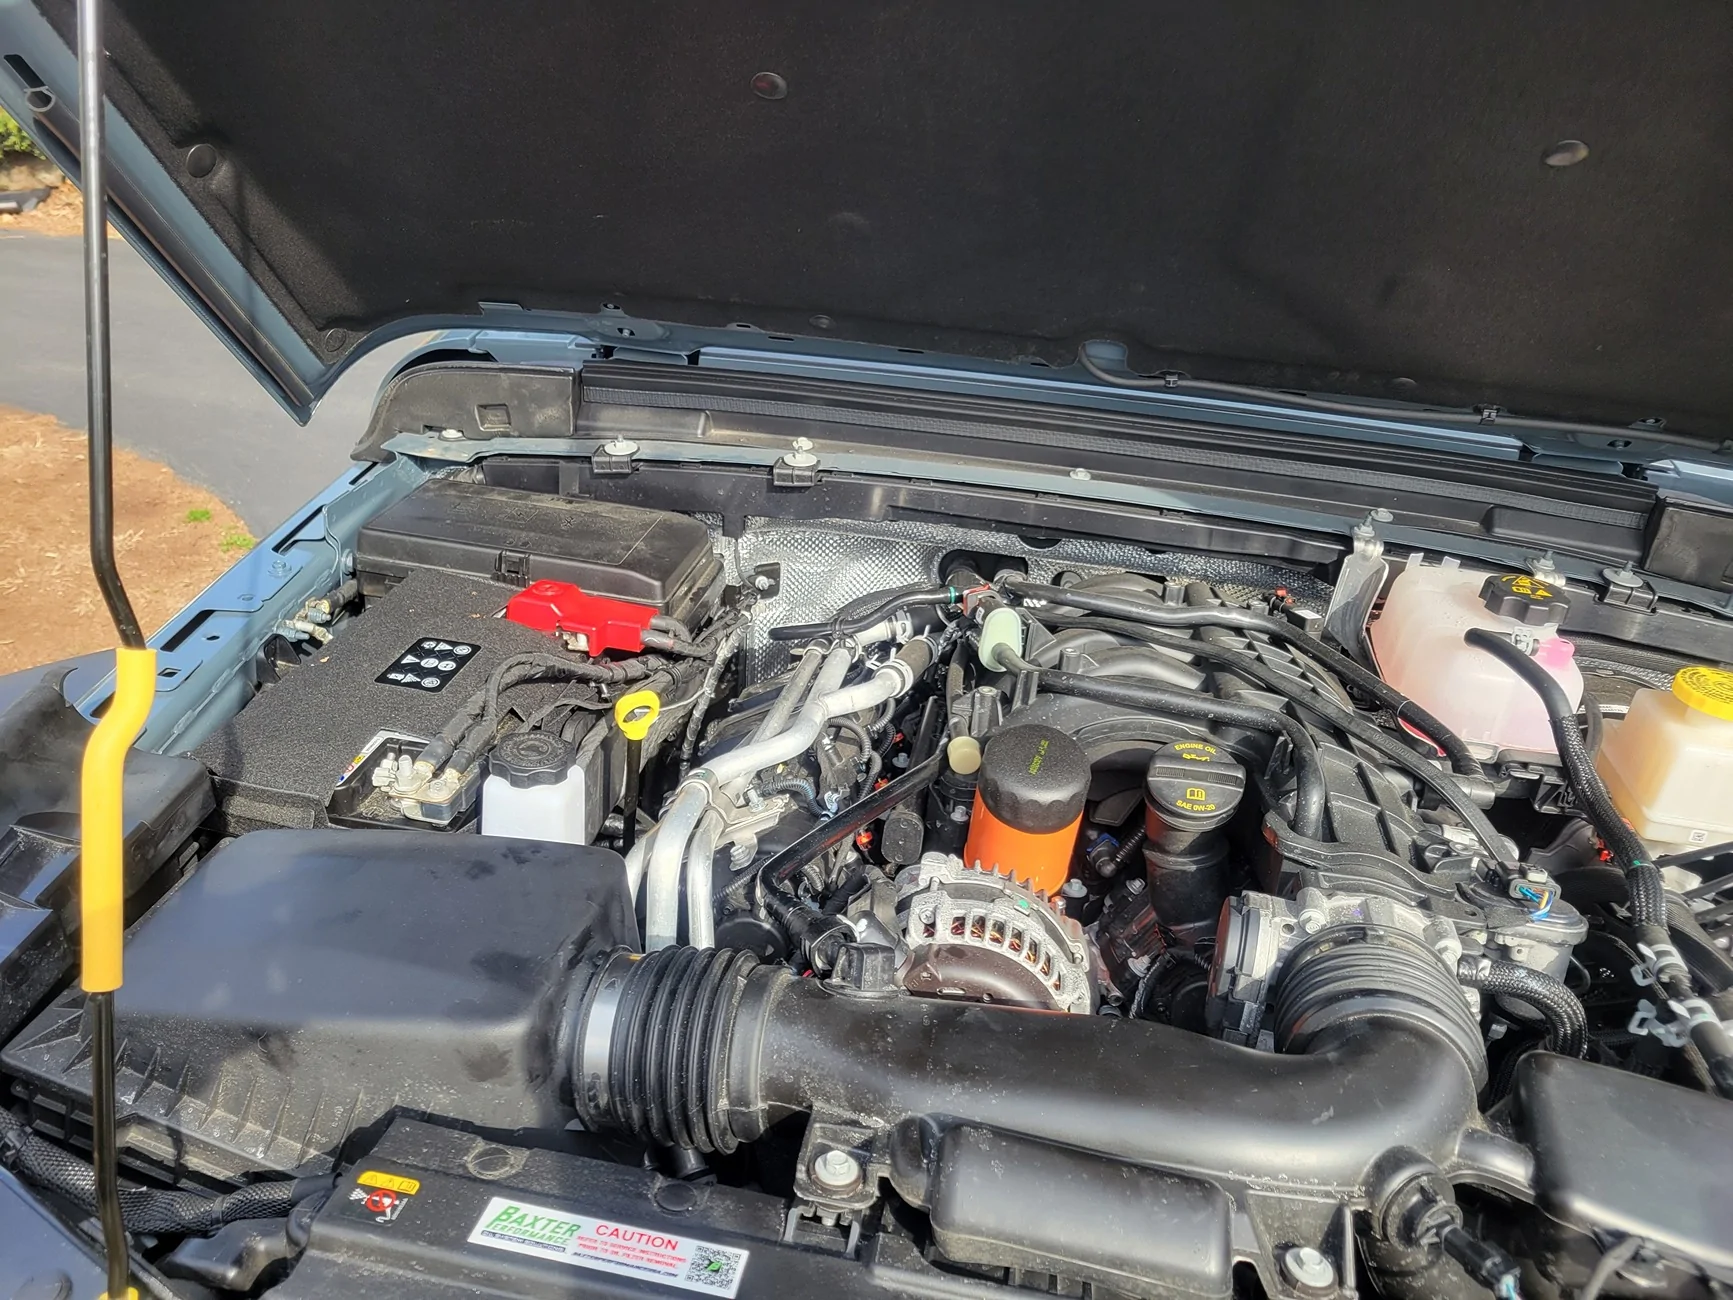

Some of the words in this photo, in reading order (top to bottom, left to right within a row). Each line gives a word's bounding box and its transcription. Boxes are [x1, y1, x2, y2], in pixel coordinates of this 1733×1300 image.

[1174, 743, 1204, 751] ENGINE
[1204, 746, 1217, 755] OIL
[1176, 800, 1192, 810] SAE
[1193, 803, 1216, 811] 0W-20
[485, 1205, 581, 1237] BAXTER
[596, 1224, 679, 1251] CAUTION
[639, 1248, 687, 1263] INSTRUCTIONS
